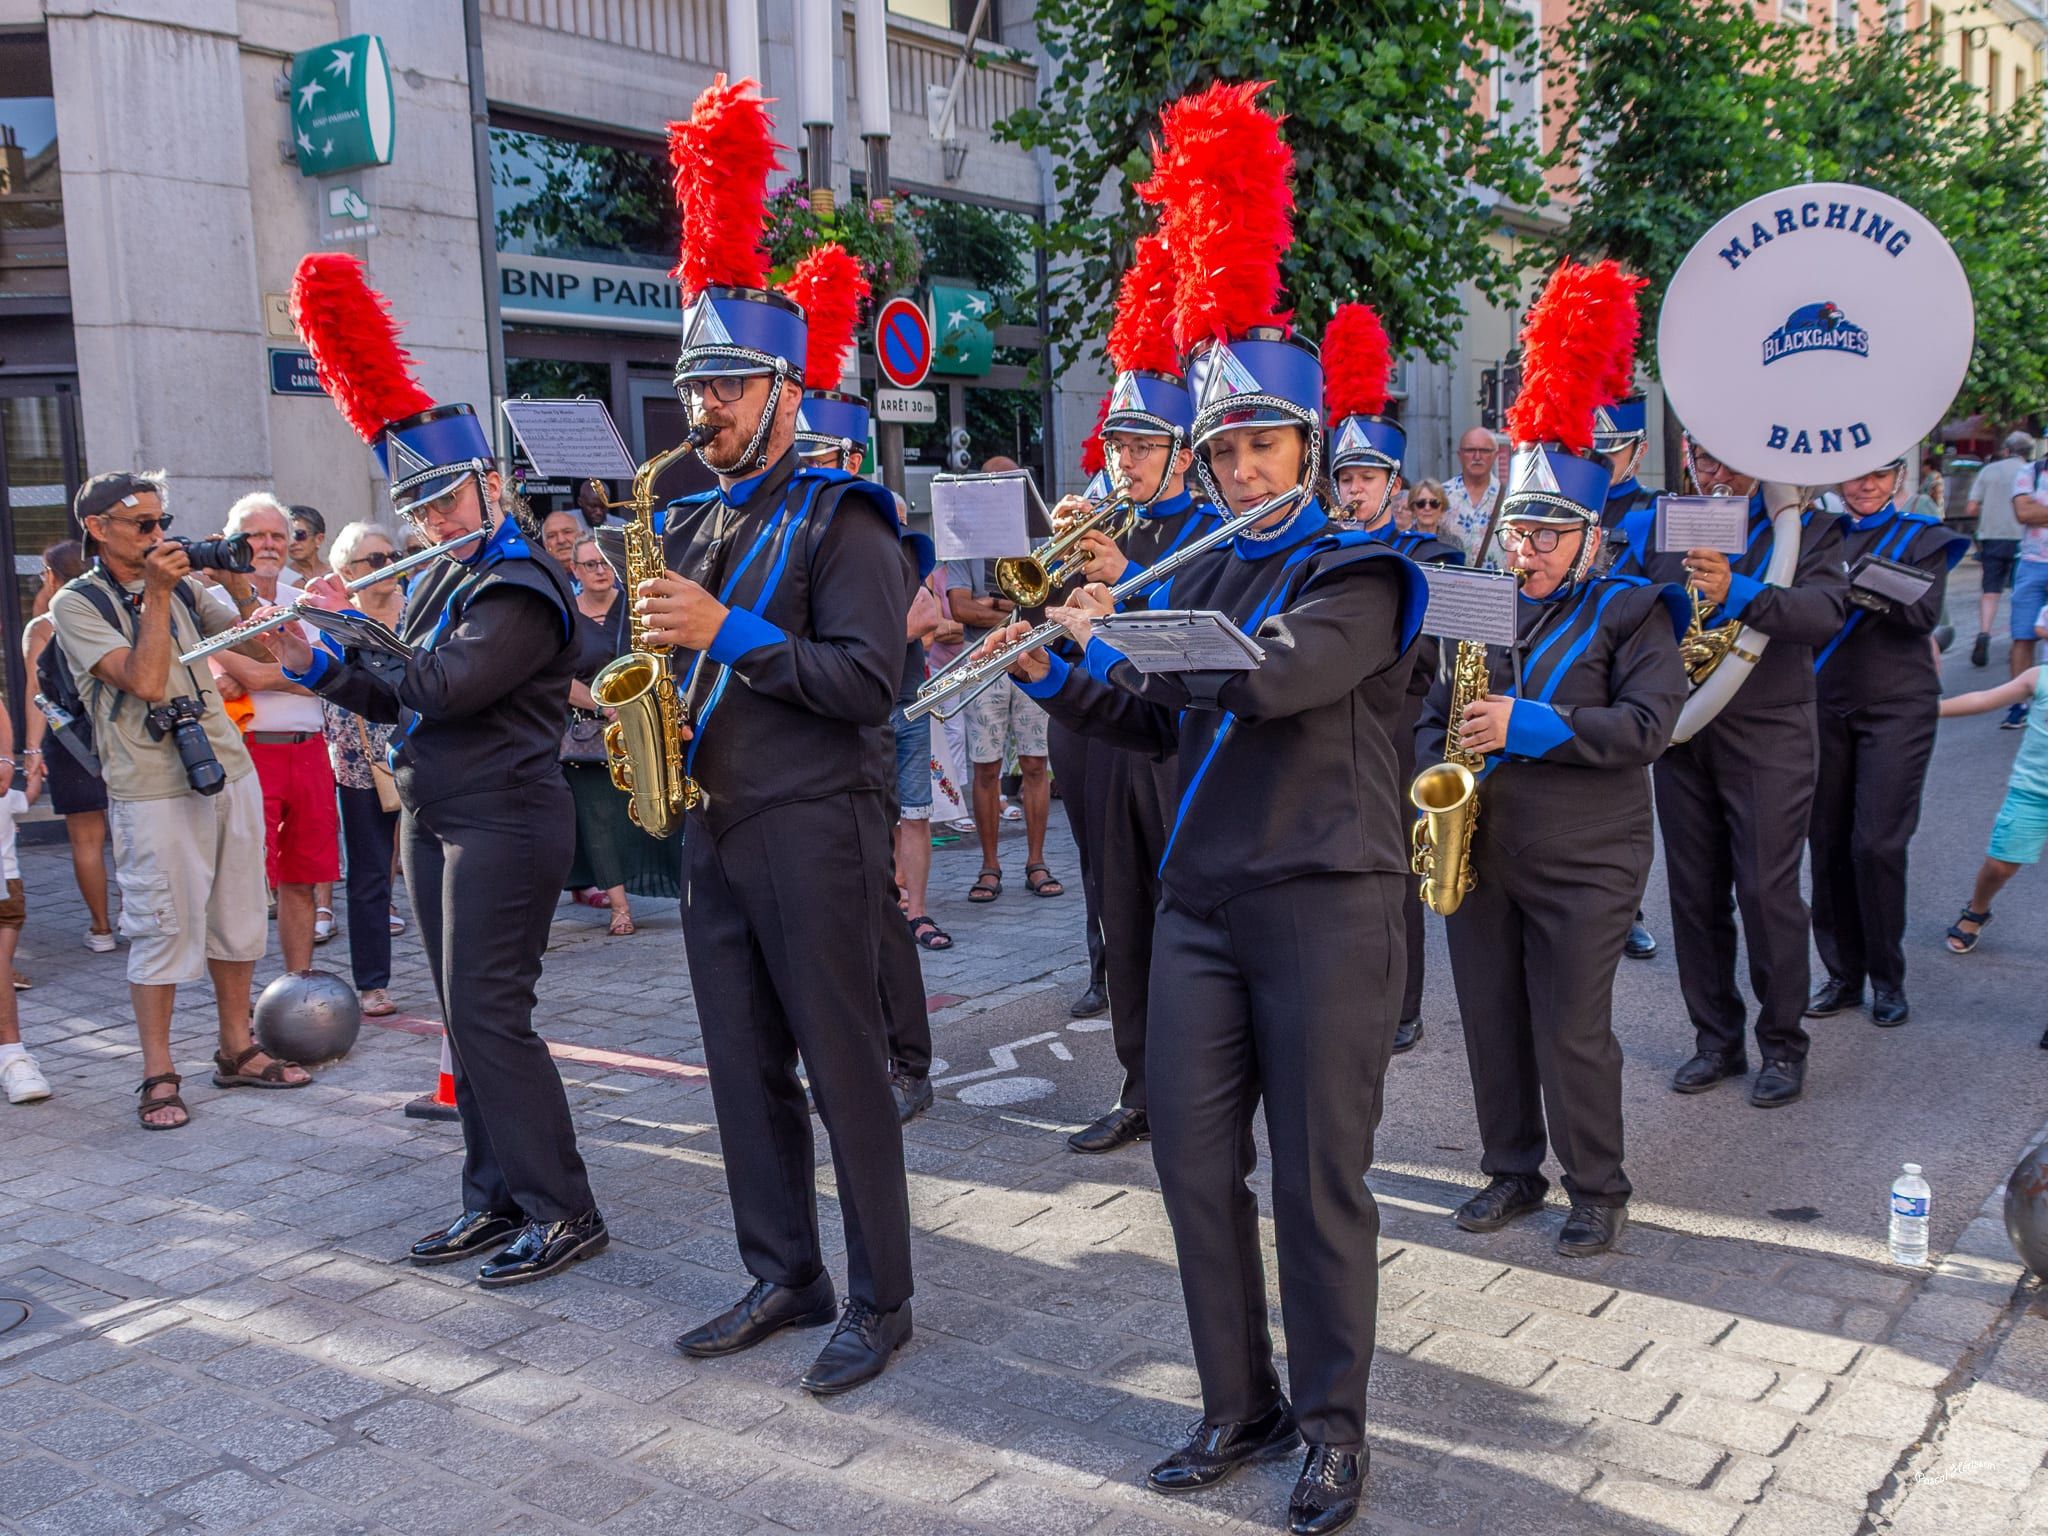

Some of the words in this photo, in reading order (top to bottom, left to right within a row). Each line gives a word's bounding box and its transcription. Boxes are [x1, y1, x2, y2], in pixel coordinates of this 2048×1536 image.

[1718, 201, 1912, 270] MARCHING
[501, 268, 580, 300] BNP
[1763, 328, 1869, 361] BLACKGAMES
[297, 357, 316, 371] RUE
[880, 397, 908, 412] ARRÊT
[912, 401, 923, 412] 30
[1766, 422, 1872, 454] BAND
